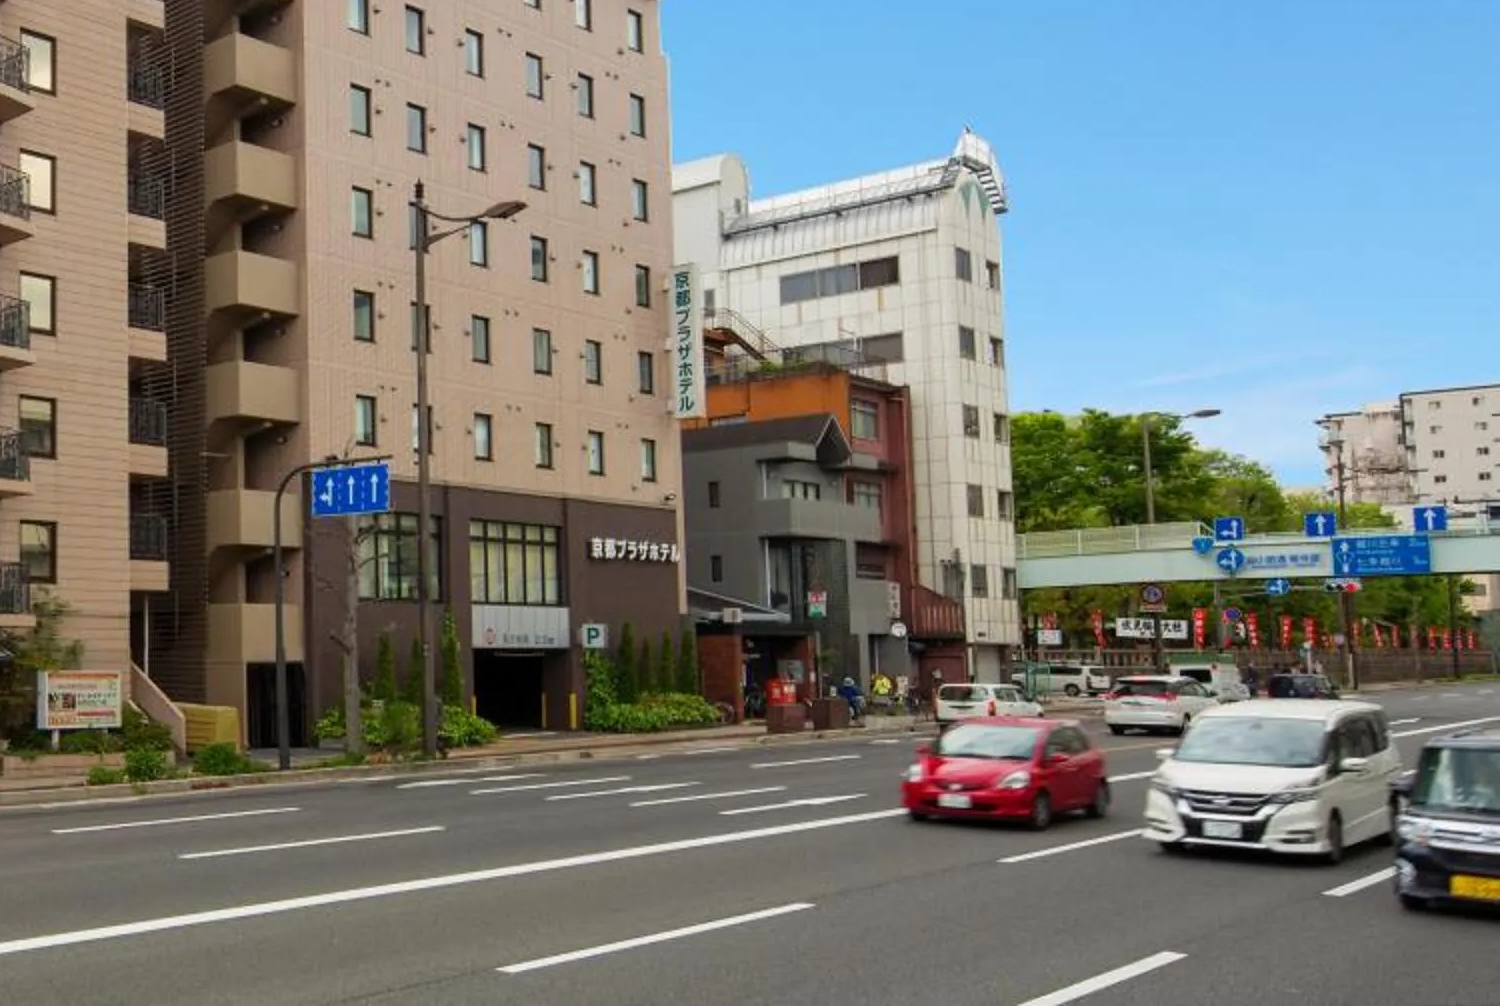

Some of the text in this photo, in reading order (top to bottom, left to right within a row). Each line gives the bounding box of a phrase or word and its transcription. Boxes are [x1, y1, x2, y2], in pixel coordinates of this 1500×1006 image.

[674, 271, 695, 412] 京都プラザホテル
[591, 536, 681, 563] 京都プラザホテル
[586, 627, 600, 644] P
[1121, 620, 1183, 633] 伏見稲大社
